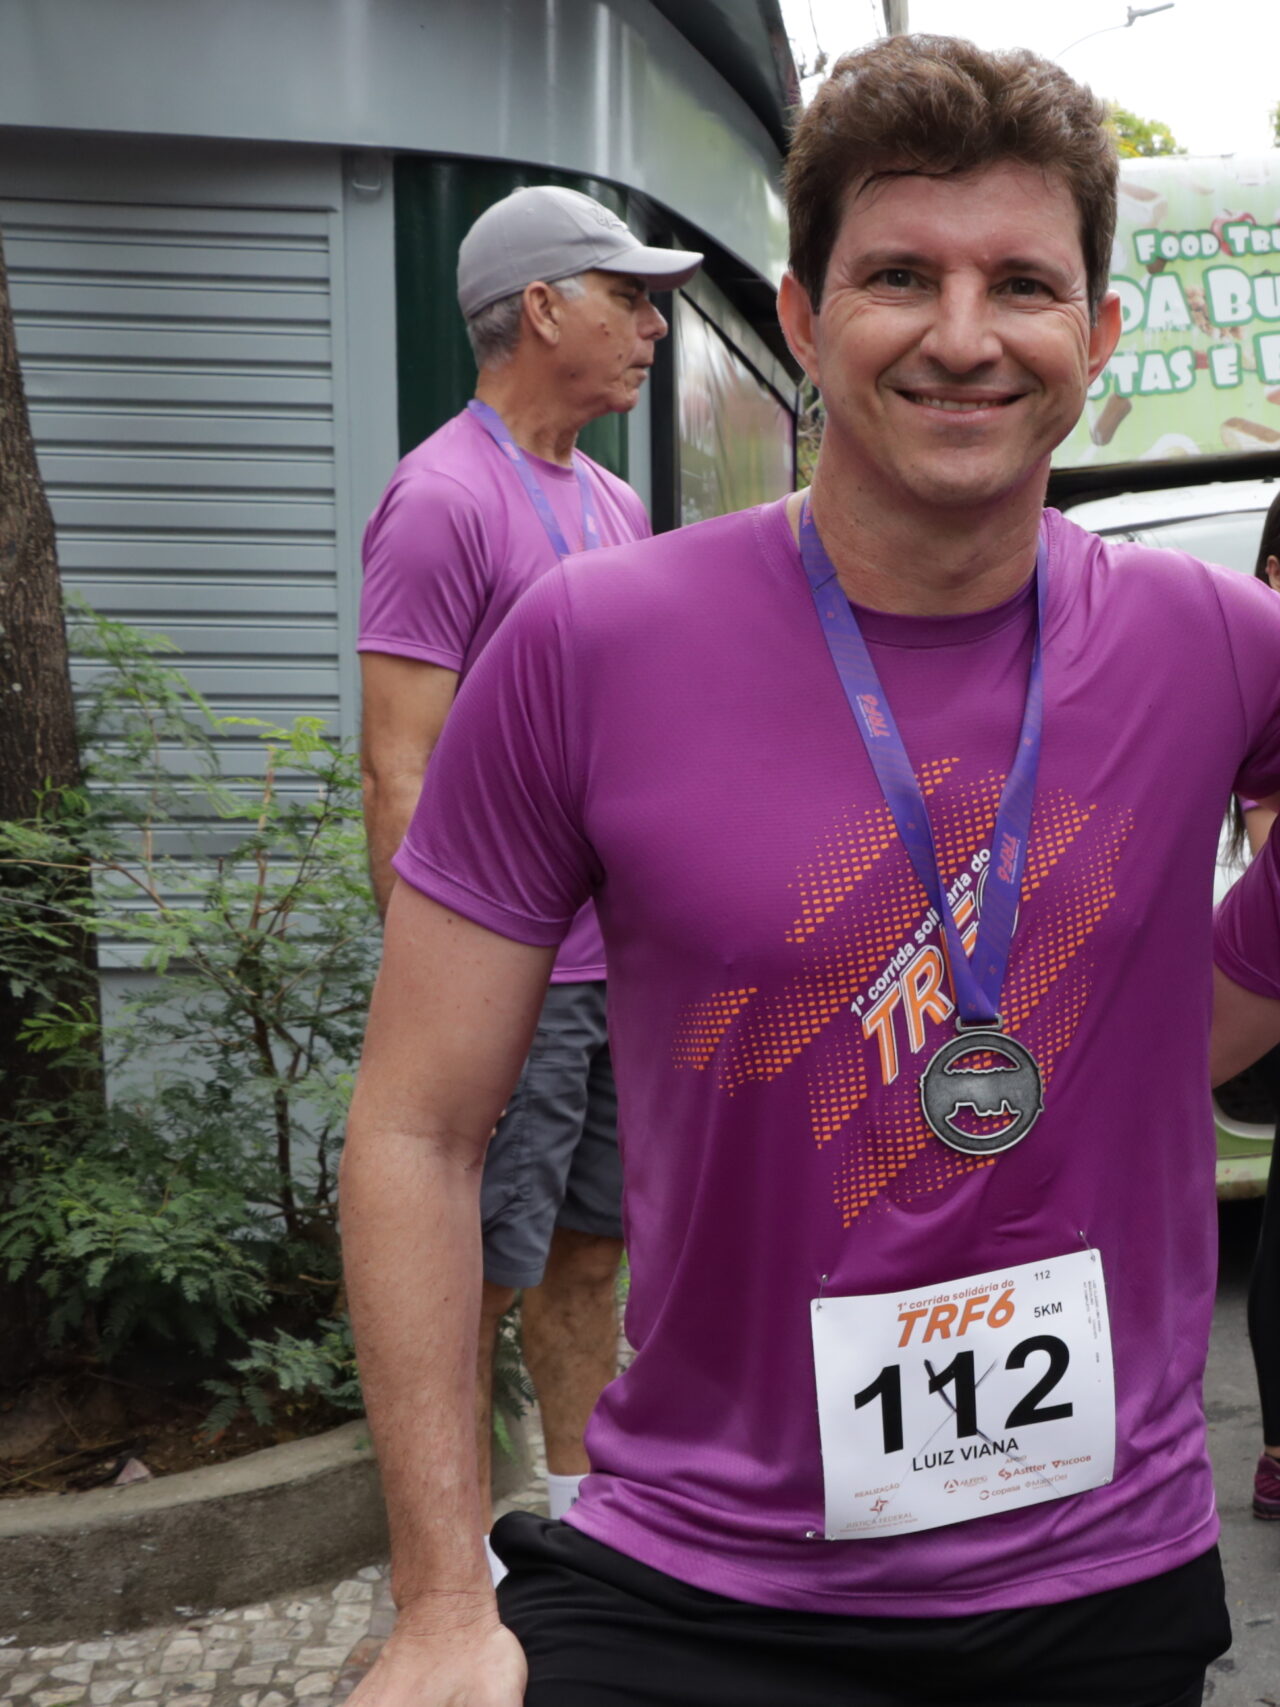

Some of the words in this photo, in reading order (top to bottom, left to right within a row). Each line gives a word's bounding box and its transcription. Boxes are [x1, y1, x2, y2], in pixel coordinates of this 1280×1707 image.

[1210, 345, 1240, 387] E
[868, 941, 916, 1002] corrida
[971, 848, 991, 872] do
[1034, 1270, 1051, 1281] 112
[909, 1296, 950, 1310] corrida
[953, 1282, 998, 1300] solidária
[1001, 1279, 1014, 1289] do
[1034, 1302, 1063, 1318] 5KM
[898, 1288, 1016, 1348] TRF6
[854, 1334, 1073, 1454] 112
[912, 1449, 955, 1472] LUIZ
[960, 1437, 1019, 1461] VIANA
[1013, 1464, 1047, 1477] Asttter
